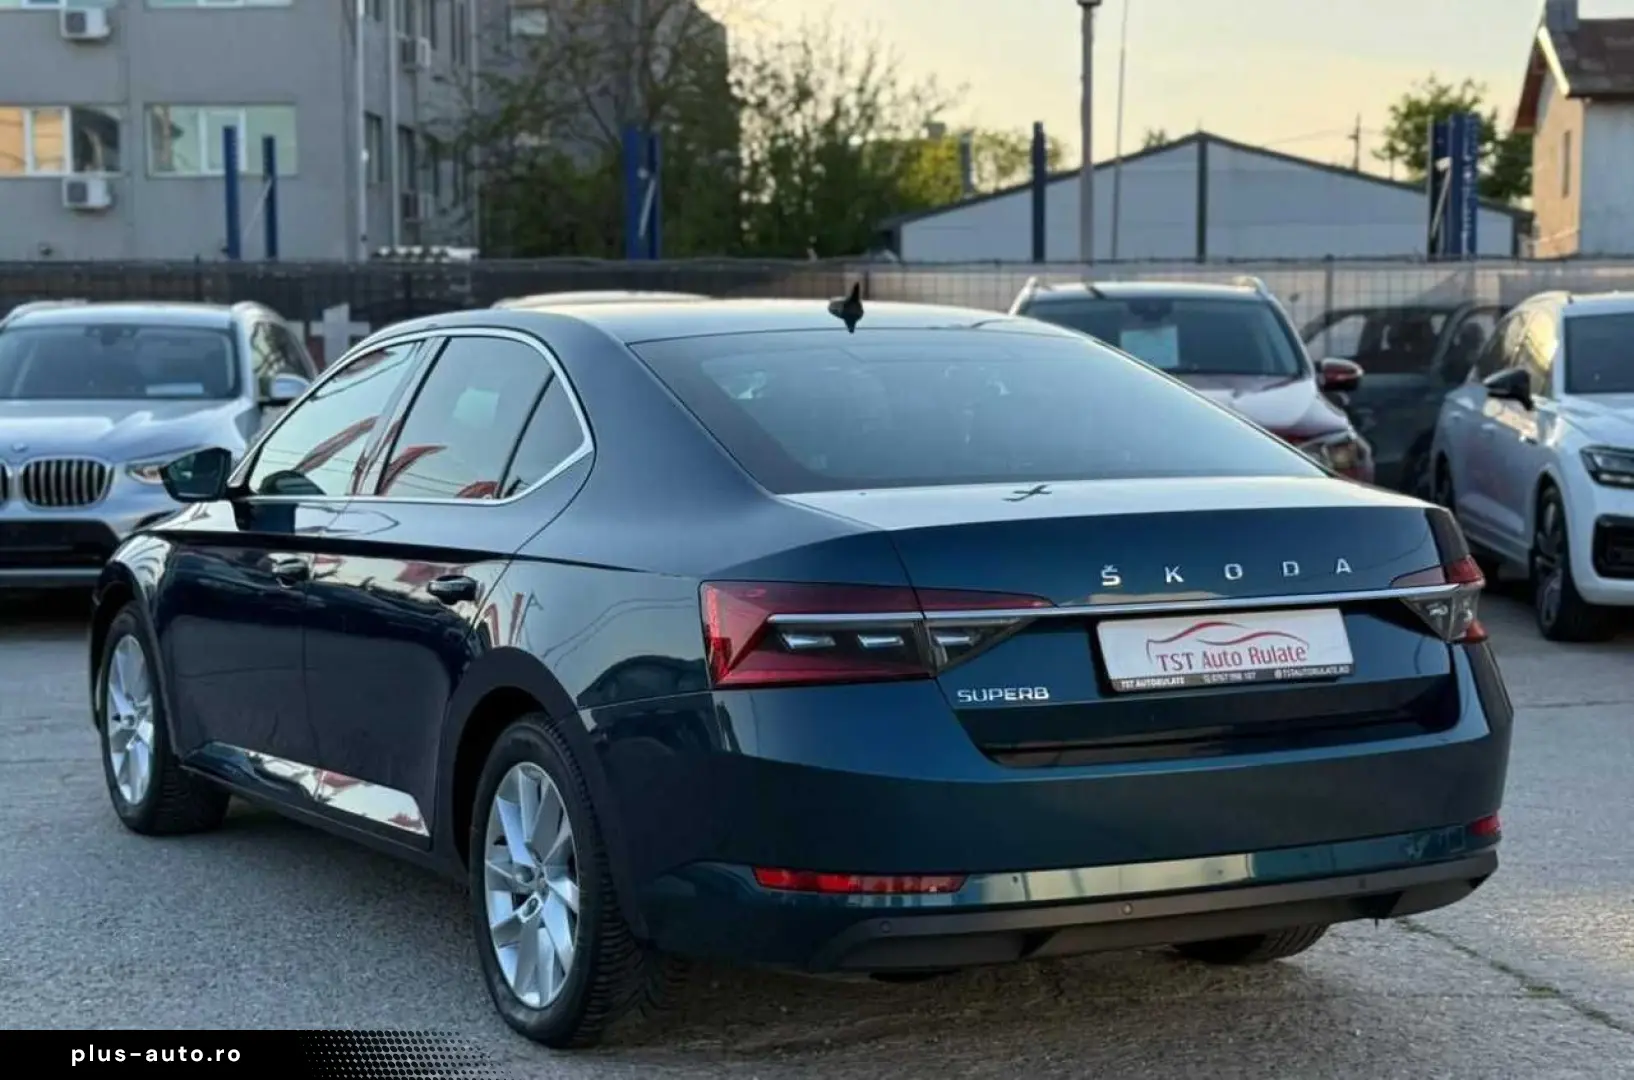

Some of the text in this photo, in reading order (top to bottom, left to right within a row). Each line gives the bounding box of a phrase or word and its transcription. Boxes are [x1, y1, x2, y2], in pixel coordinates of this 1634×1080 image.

[1101, 558, 1352, 587] ŠKODA
[1155, 643, 1308, 672] TST Auto Rulate
[957, 686, 1049, 703] SUPERB
